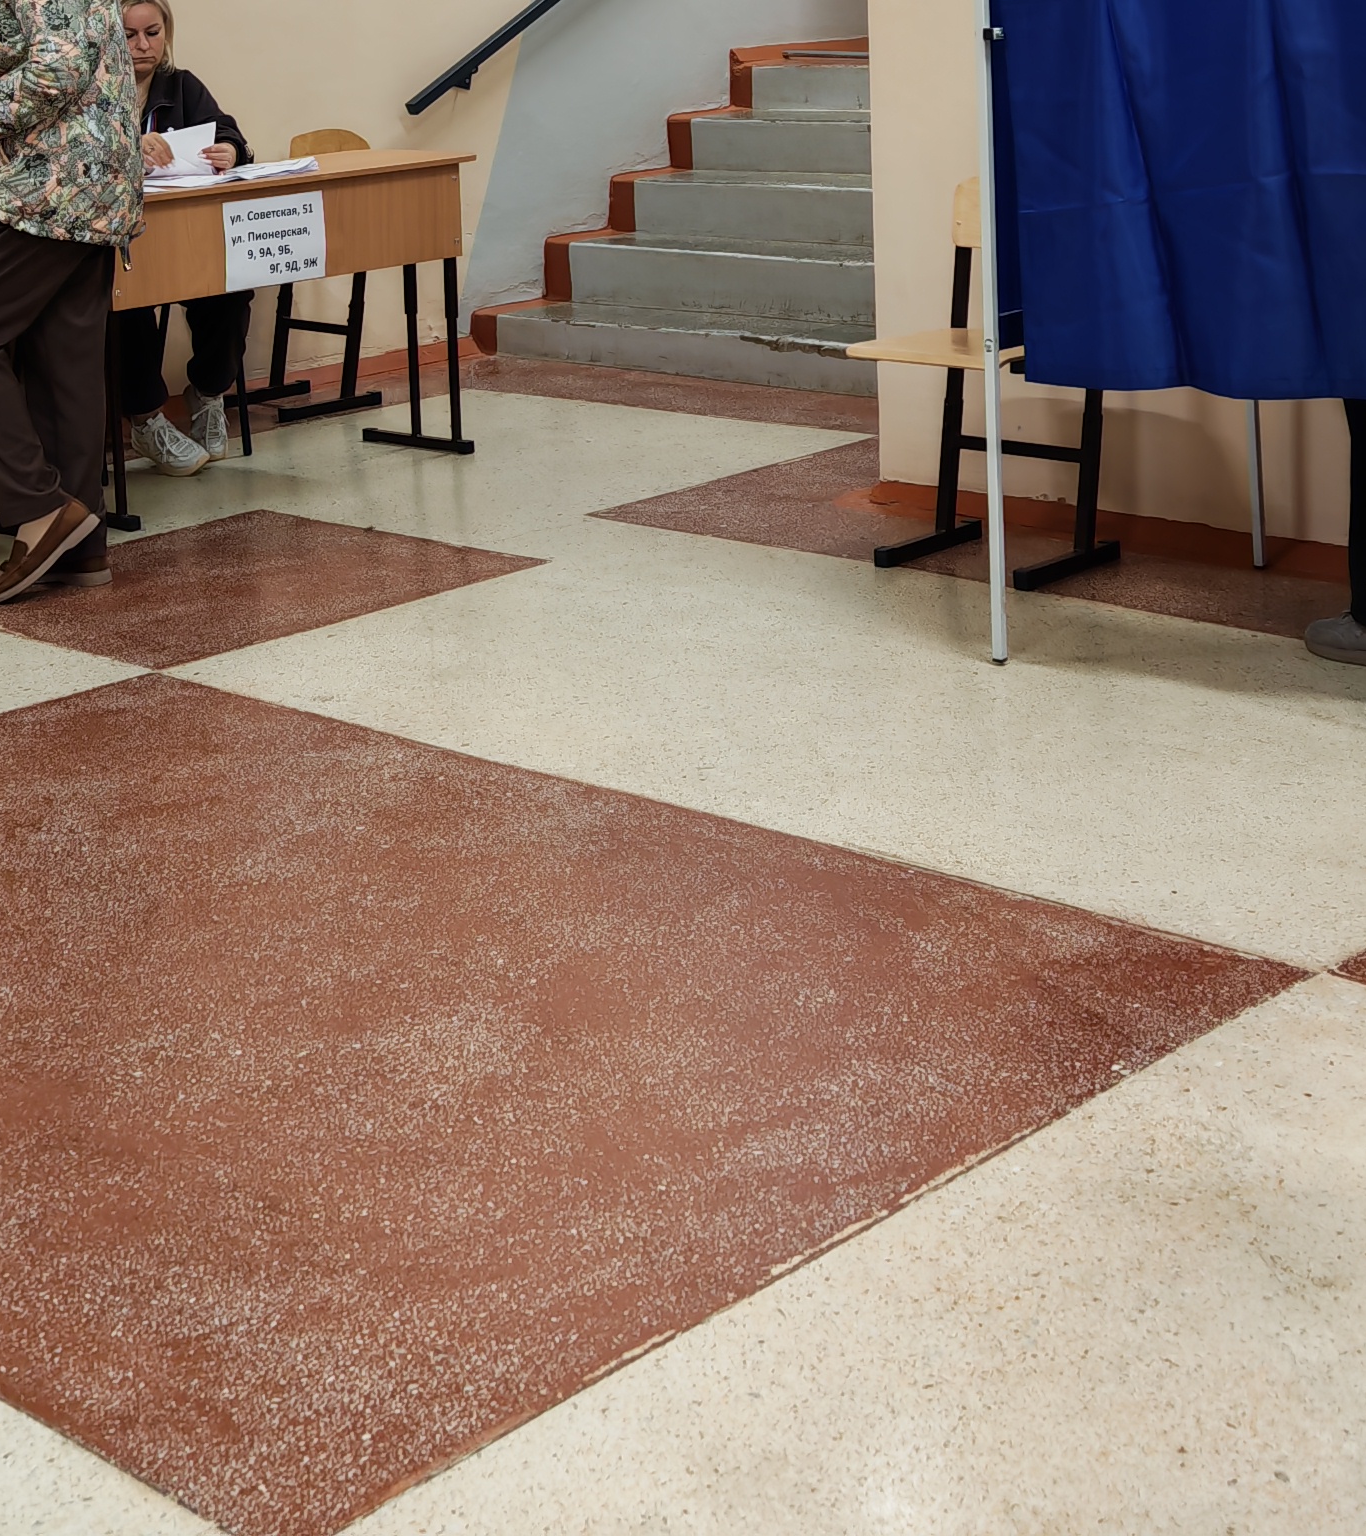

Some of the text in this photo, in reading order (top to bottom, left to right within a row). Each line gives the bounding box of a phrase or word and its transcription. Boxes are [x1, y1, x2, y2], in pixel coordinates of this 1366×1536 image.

[230, 203, 314, 226] ул. Советская, 51
[231, 226, 311, 247] ул. Пионерская,
[247, 244, 293, 260] 9, 9А, 9Б,
[269, 257, 319, 274] 9Г, 9Д, 9Ж
